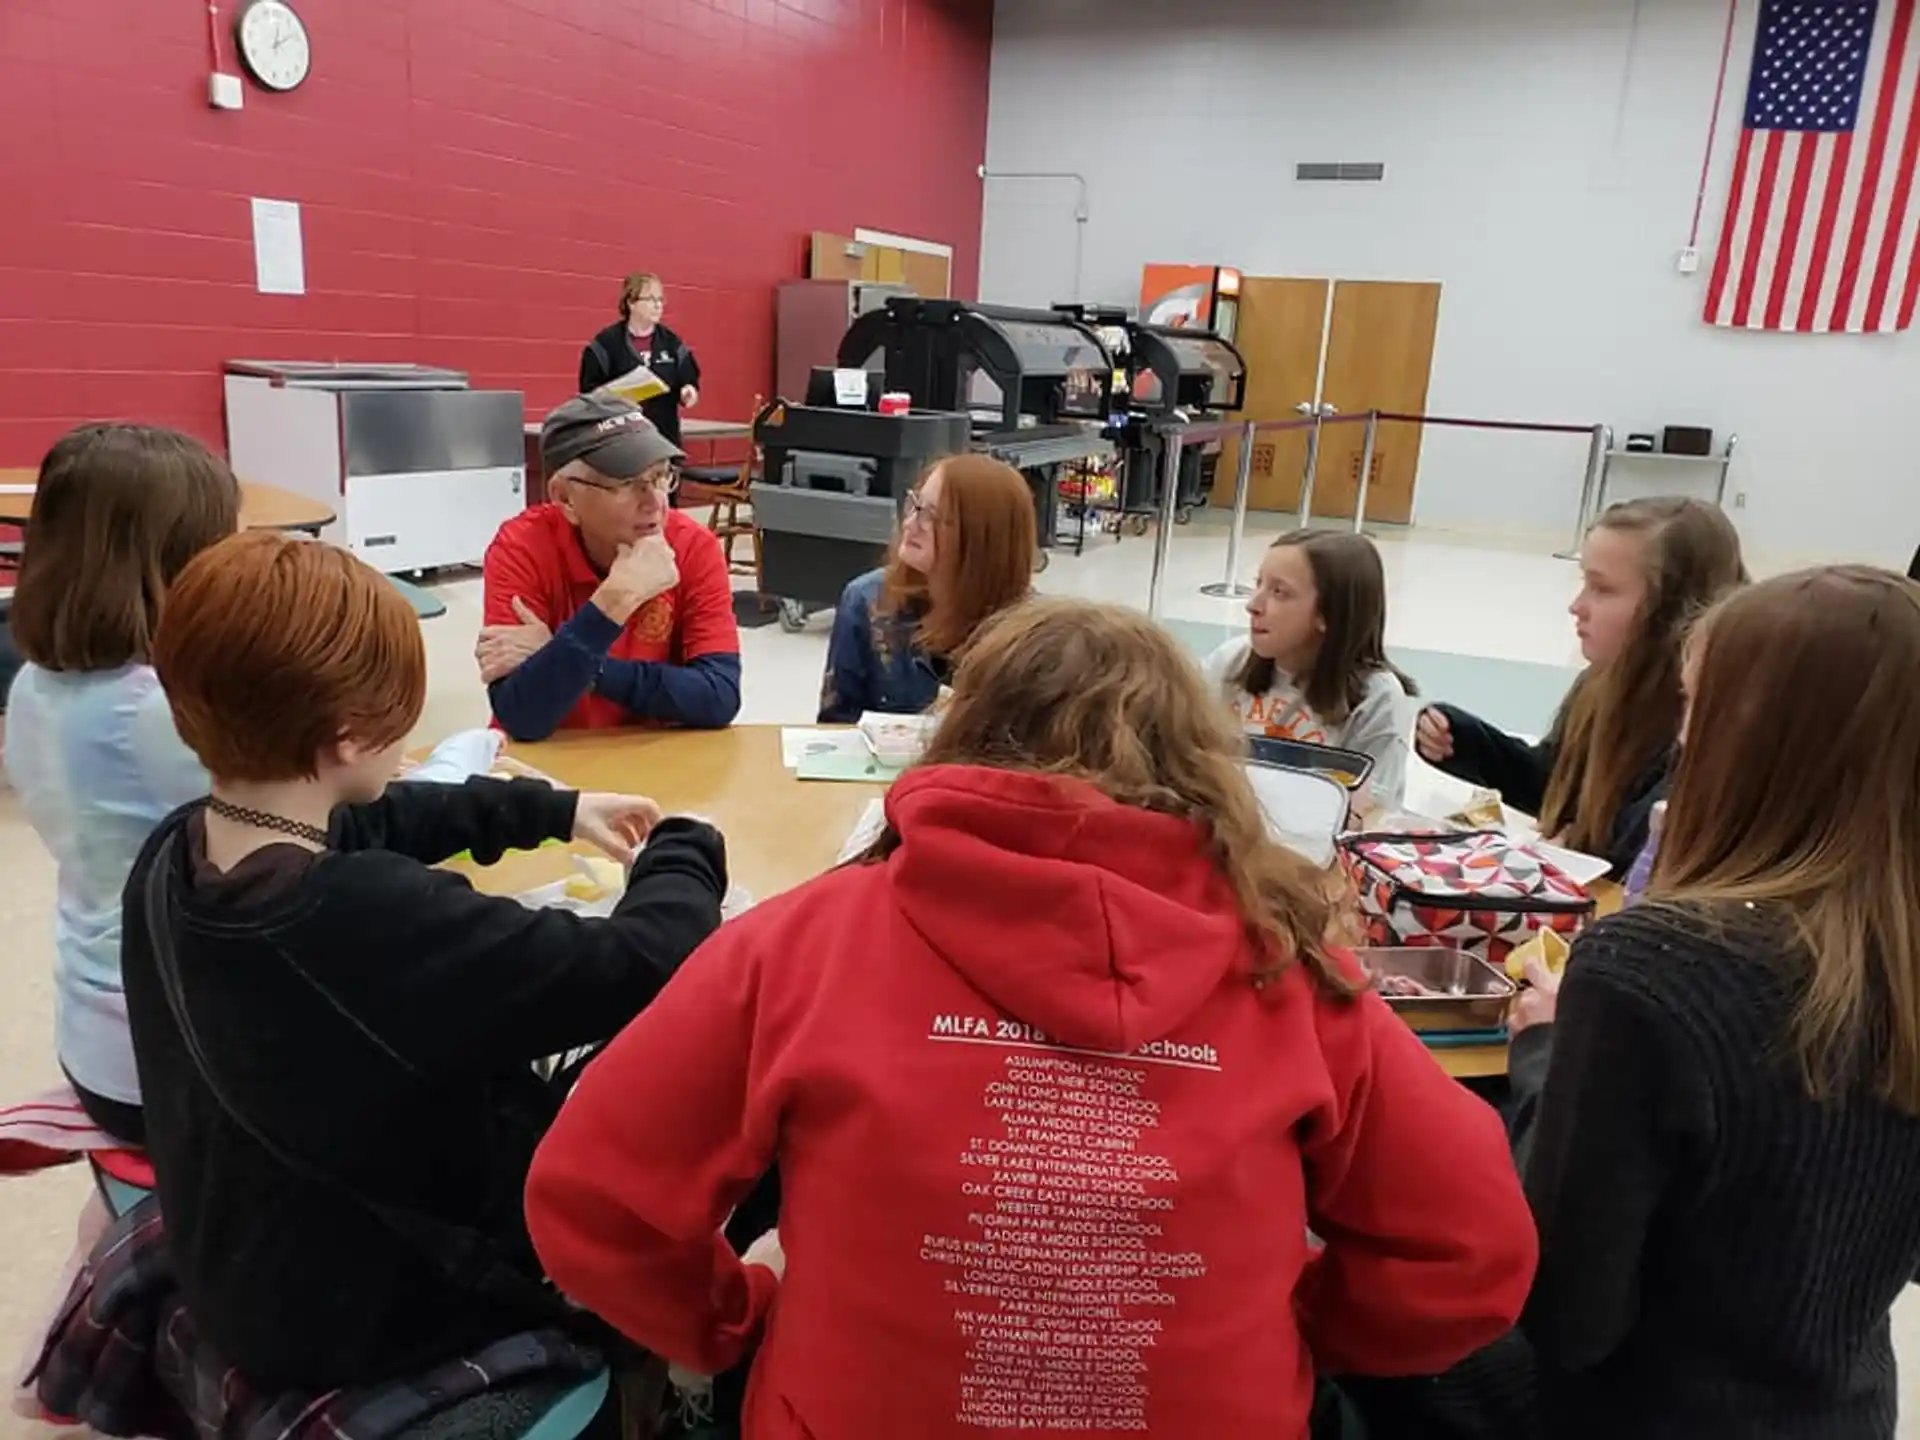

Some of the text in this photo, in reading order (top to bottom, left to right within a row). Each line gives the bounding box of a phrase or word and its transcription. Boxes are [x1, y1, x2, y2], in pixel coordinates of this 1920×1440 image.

[932, 1015, 989, 1036] MLFA
[1005, 1055, 1147, 1082] ASSUMPTION CATHOLIC
[1008, 1070, 1054, 1083] GOLDA
[1088, 1079, 1139, 1096] SCHOOL
[985, 1082, 1160, 1113] JOHN LONG MIDDLE SCHOOL
[984, 1097, 1159, 1127] LAKE SHORE MIDDLE SCHOOL
[1026, 1129, 1082, 1146] FRANCES
[1041, 1117, 1085, 1133] MIDDLE
[1089, 1121, 1141, 1139] SCHOOL
[988, 1140, 1047, 1156] DOMINIC
[1050, 1145, 1113, 1163] CATHOLIC
[1118, 1153, 1170, 1167] SCHOOL
[960, 1152, 1178, 1181] SILVER LAKE INTERMEDIATE SCHOOL
[993, 1171, 1144, 1194] XAVIER MIDDLE SCHOOL
[962, 1182, 1173, 1210] OAK CREEK EAST MIDDLE SCHOOL
[996, 1200, 1139, 1221] WEBSTER TRANSITIONAL
[968, 1213, 1163, 1236] PILGRIM PARK MIDDLE SCHOOL
[924, 1234, 1202, 1265] RUFUS KING INTERNATIONAL MIDDLE SCHOOL
[985, 1228, 1145, 1249] BADGER MIDDLE SCHOOL
[920, 1248, 1206, 1278] CHRISTIAN EDUCATION LEADERSHIP ACADEMY
[964, 1270, 1159, 1292] LONGFELLOW MIDDLE SCHOOL
[945, 1280, 1175, 1306] SILVERBROOK INTERMEDIATE SCHOOL
[955, 1310, 1162, 1332] MILWAUKEE JEWISH DAY SCHOOL
[976, 1341, 1140, 1360] CENTRAL MIDDLE SCHOOL
[1103, 1334, 1157, 1346] SCHOOL
[1045, 1359, 1091, 1371] MIDDLE
[1095, 1362, 1148, 1373] SCHOOL
[1033, 1371, 1080, 1381] MIDDLE
[1084, 1373, 1136, 1384] SCHOOL
[980, 1388, 1017, 1401] JOHN
[1092, 1395, 1144, 1407] SCHOOL
[1097, 1385, 1150, 1396] SCHOOL
[962, 1400, 1143, 1417] LINCOLN CENTER OF THE ARTS
[1020, 1417, 1043, 1429] BAY
[1048, 1419, 1092, 1430] MIDDLE
[1096, 1419, 1150, 1431] SCHOOL
